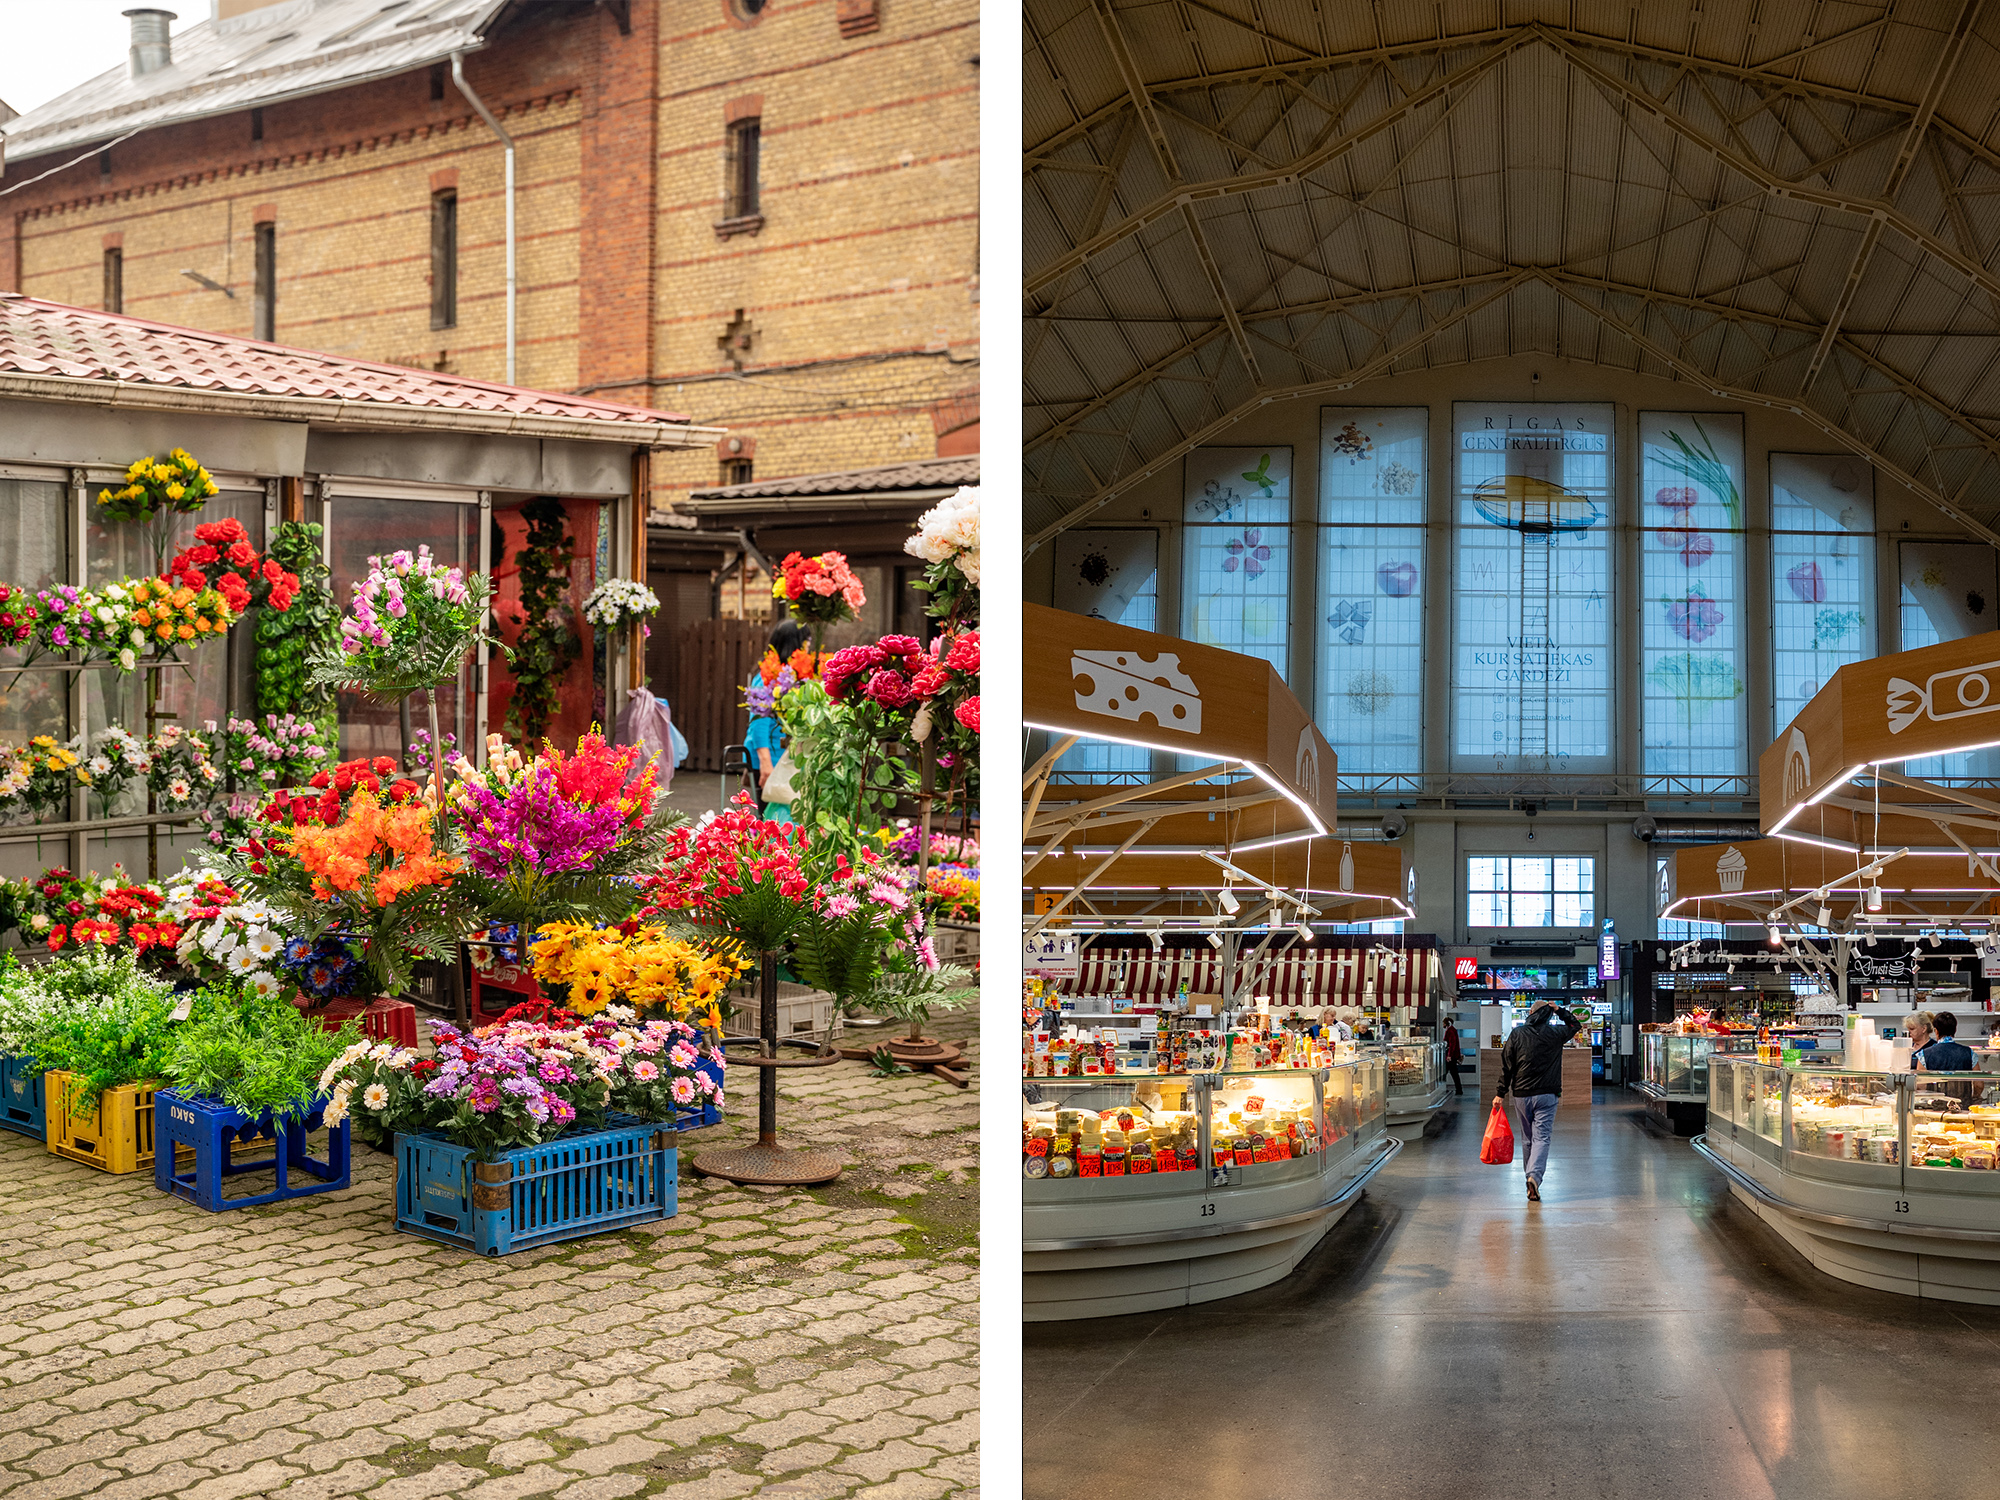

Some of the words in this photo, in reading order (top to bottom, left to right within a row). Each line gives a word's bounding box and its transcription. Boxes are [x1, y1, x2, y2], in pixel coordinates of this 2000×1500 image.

[1484, 414, 1585, 430] RĪGAS
[1465, 435, 1604, 450] CENTRĀLTIRGUS
[1507, 636, 1560, 650] VIETA,
[1474, 653, 1509, 665] KUR
[1513, 653, 1593, 666] SATIEKAS
[1496, 667, 1571, 681] GARDĒŽI
[1602, 936, 1615, 976] DZĒRIENI
[1456, 960, 1477, 978] illy
[170, 1105, 195, 1124] SAKU
[1201, 1203, 1216, 1217] 13
[1895, 1200, 1909, 1213] 13
